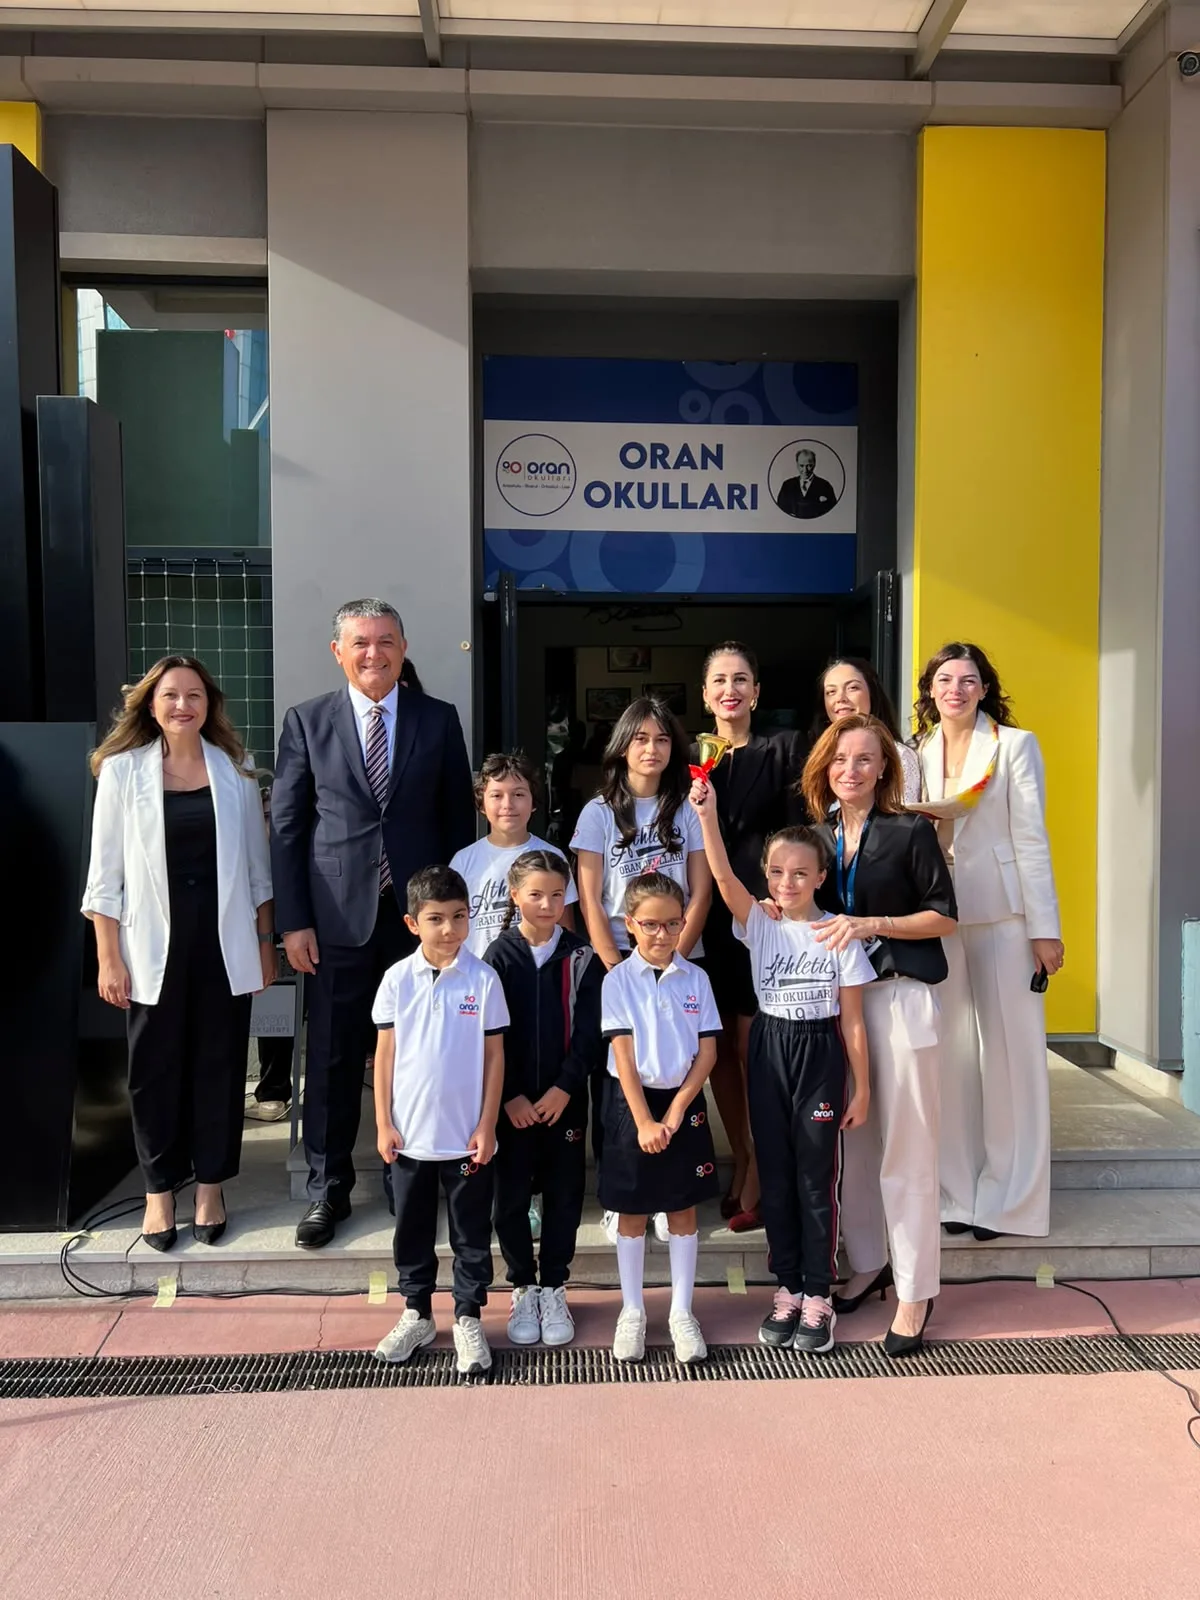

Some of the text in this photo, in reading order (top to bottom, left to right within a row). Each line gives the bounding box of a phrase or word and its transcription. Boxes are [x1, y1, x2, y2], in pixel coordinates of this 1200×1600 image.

[619, 441, 724, 471] ORAN
[527, 461, 570, 475] oran
[583, 480, 758, 510] OKULLARI
[619, 851, 684, 875] ORAN OKLLARI
[476, 913, 497, 927] RAN
[813, 1109, 834, 1118] oran
